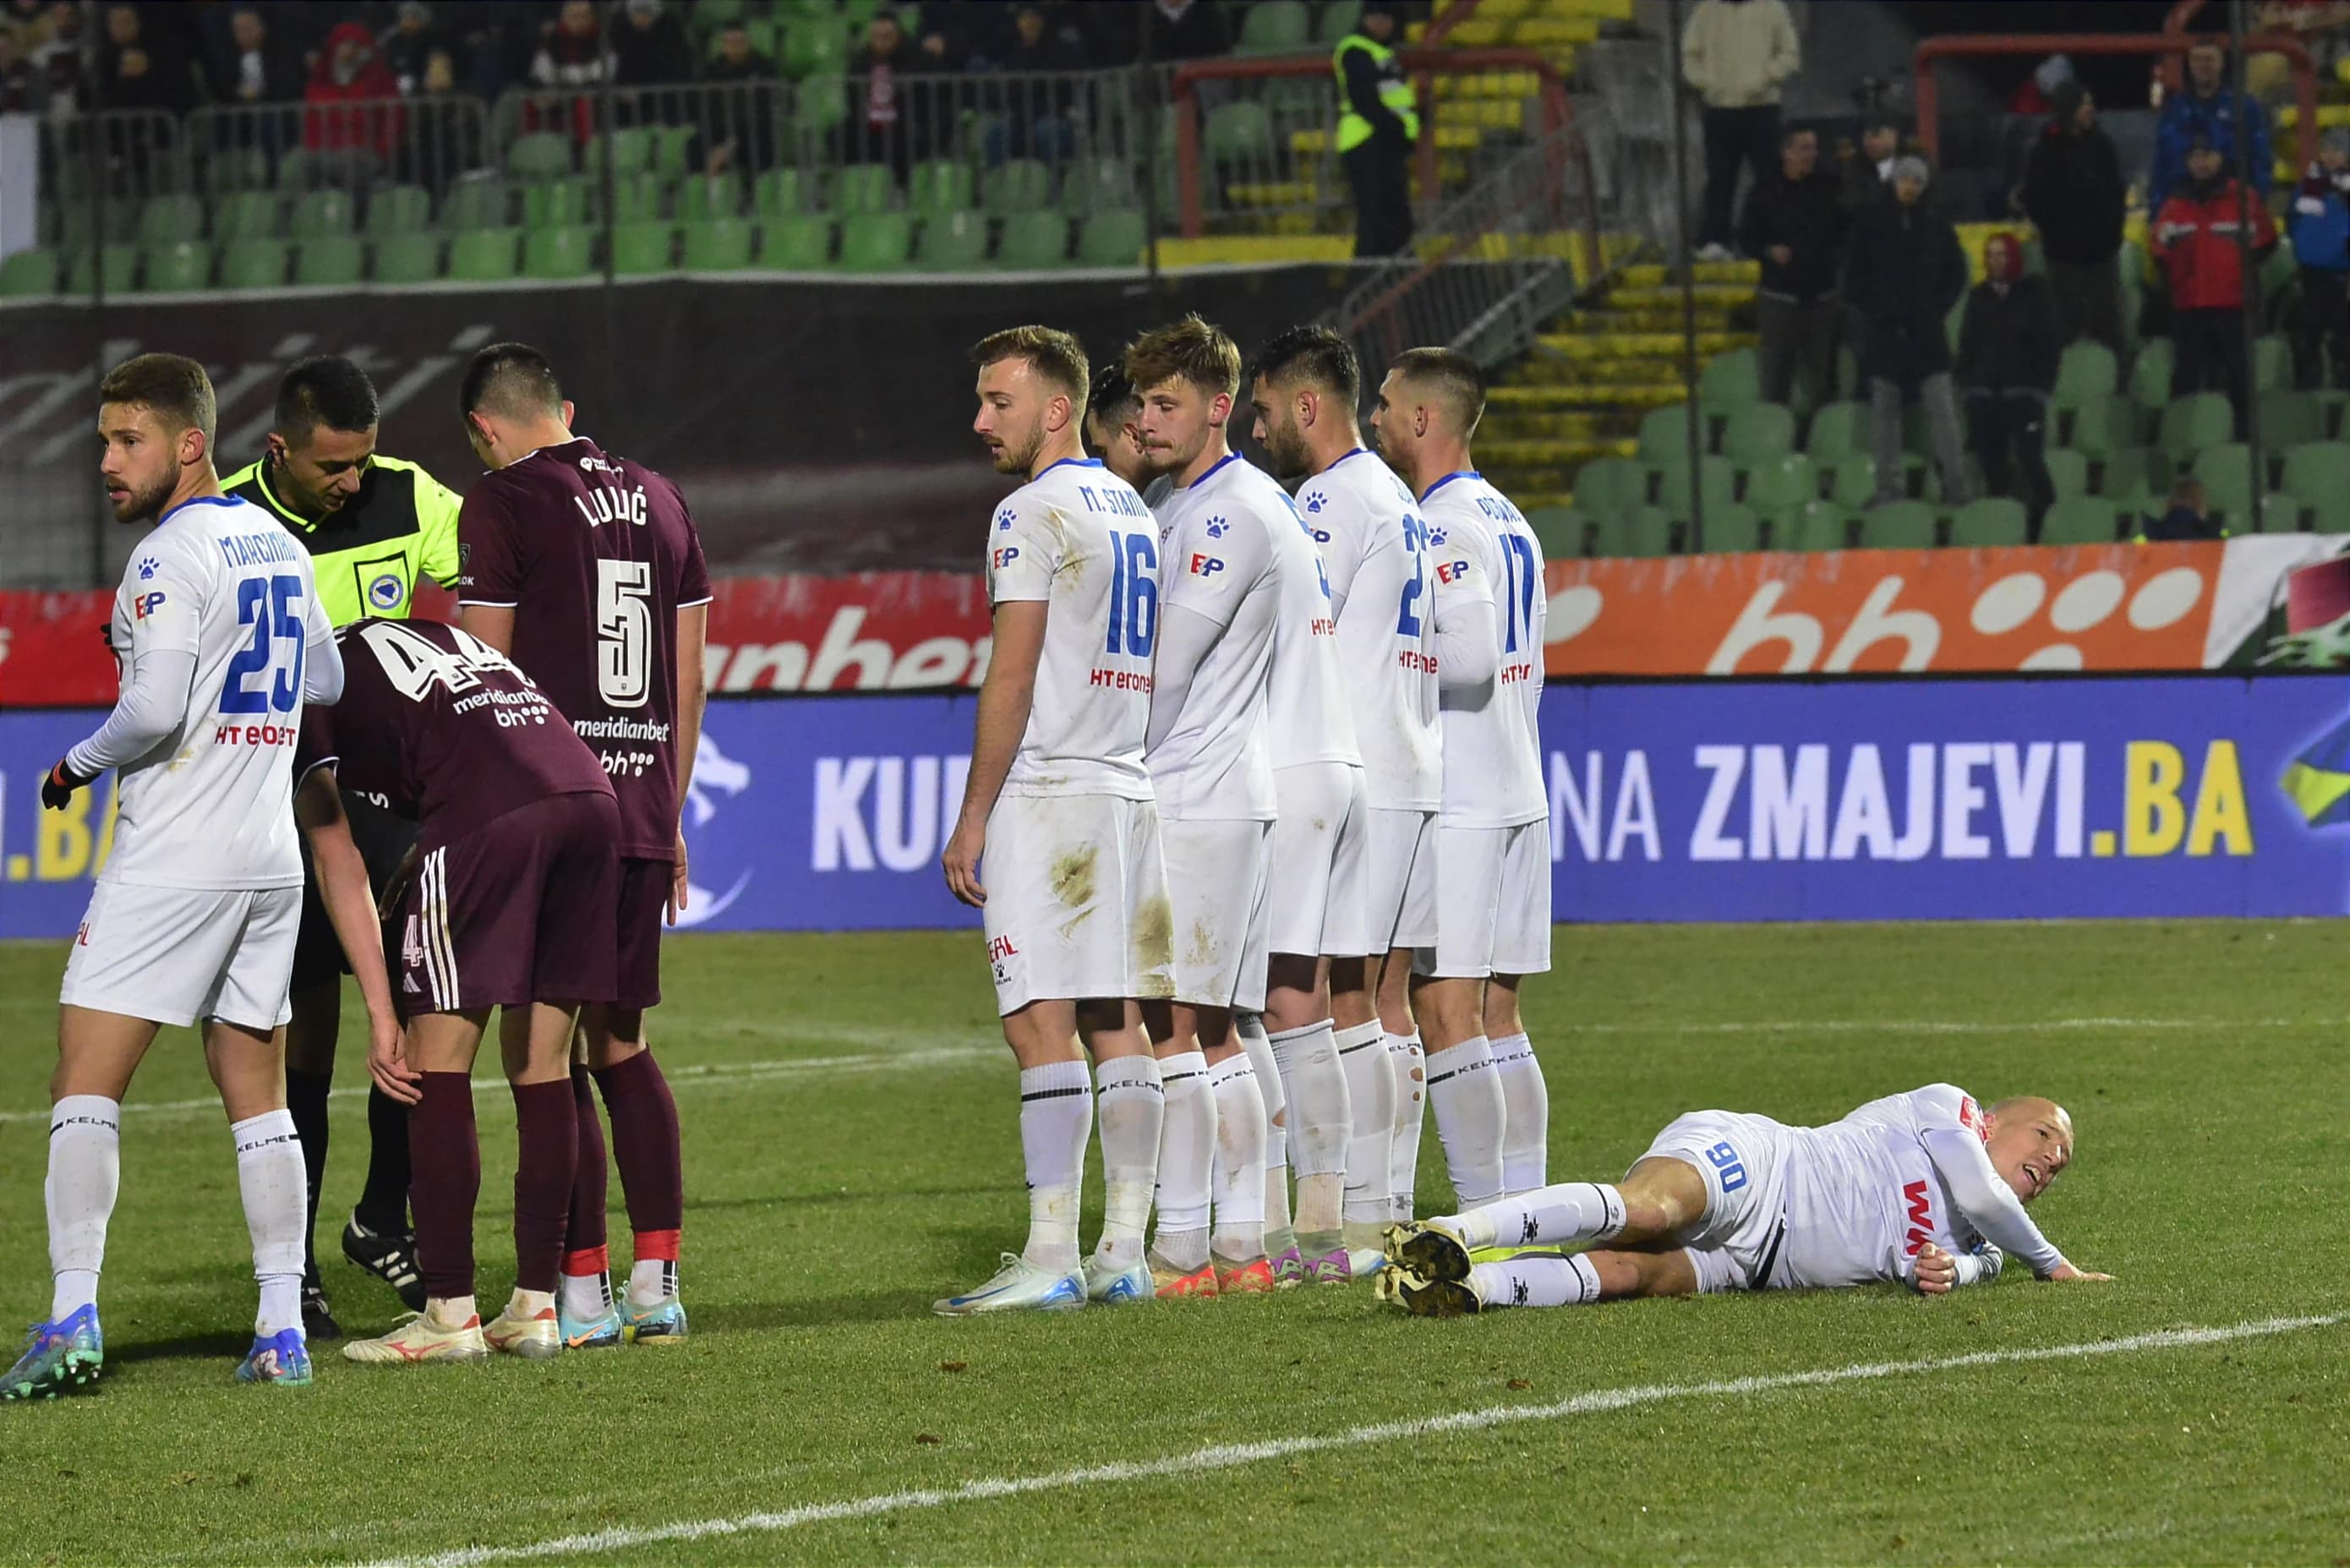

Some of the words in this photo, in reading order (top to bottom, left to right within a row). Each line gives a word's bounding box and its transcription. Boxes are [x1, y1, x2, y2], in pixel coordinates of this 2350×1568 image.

[218, 575, 305, 714] 25
[597, 559, 652, 708] 5
[1107, 530, 1157, 658] 16
[1499, 533, 1535, 654] 17
[573, 718, 669, 742] meridianbet
[1689, 740, 2255, 861] ZMAJEVI.BA
[238, 1134, 288, 1153] KELME
